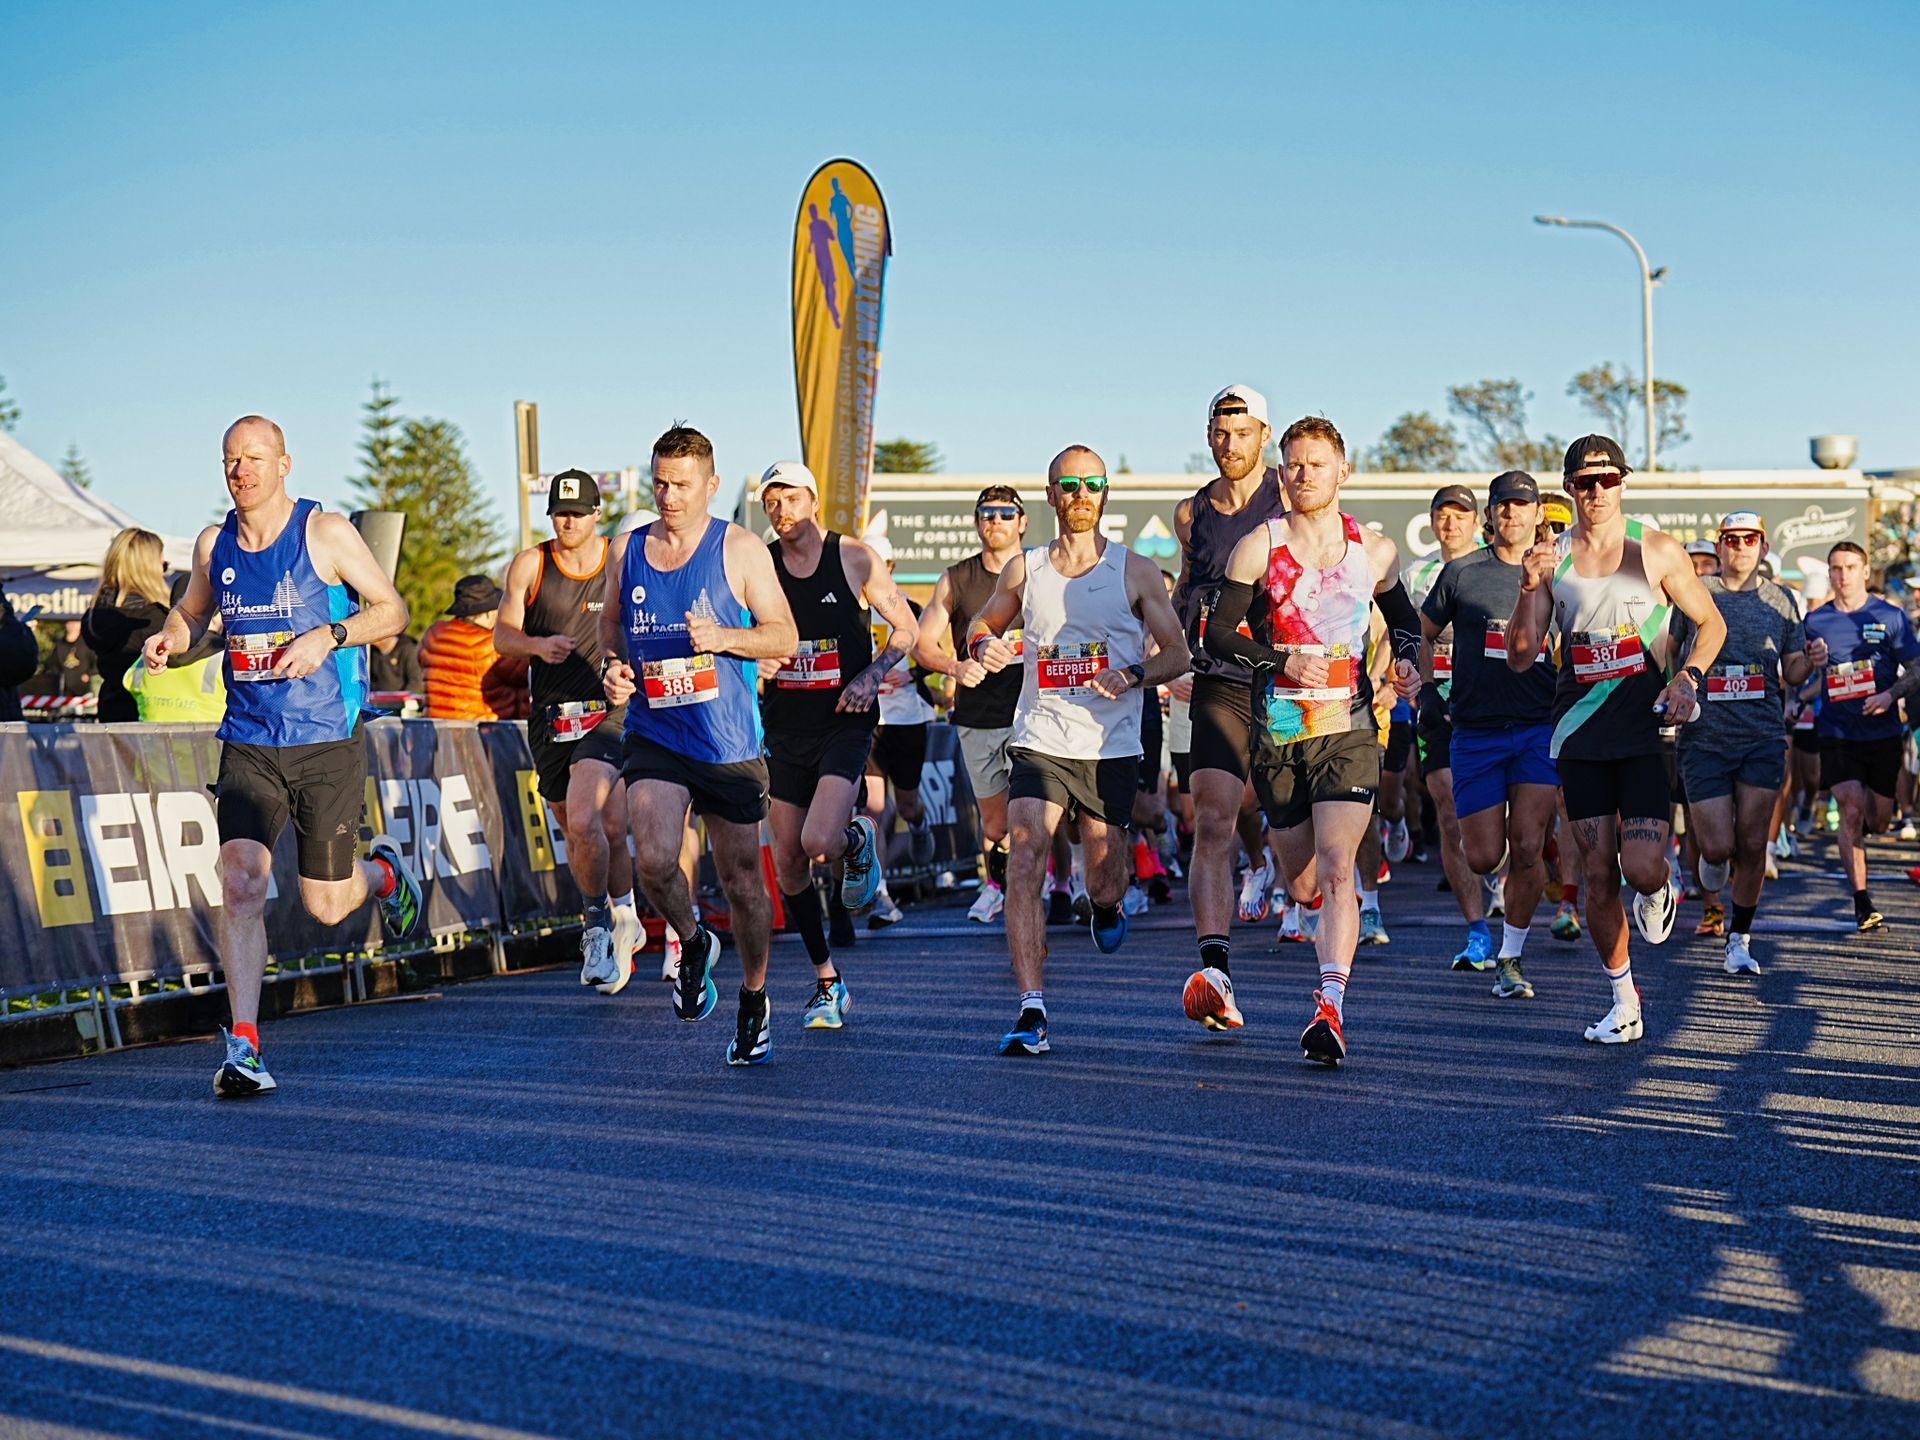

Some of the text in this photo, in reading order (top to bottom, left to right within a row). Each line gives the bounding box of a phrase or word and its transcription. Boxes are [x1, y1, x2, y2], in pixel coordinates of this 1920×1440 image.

[855, 203, 881, 343] WATCHING
[836, 423, 851, 503] RUNNING
[892, 515, 925, 528] THE
[1657, 513, 1698, 525] WITH
[1701, 513, 1713, 525] A
[221, 604, 277, 616] ORT PACERS
[246, 653, 273, 671] 377
[1590, 645, 1618, 664] 387
[793, 658, 816, 672] 417
[1046, 661, 1099, 677] BEEPBEEP
[662, 676, 694, 697] 388
[1067, 675, 1076, 686] 11
[1723, 679, 1748, 692] 409
[379, 774, 493, 882] EIRE
[80, 791, 279, 916] EIR
